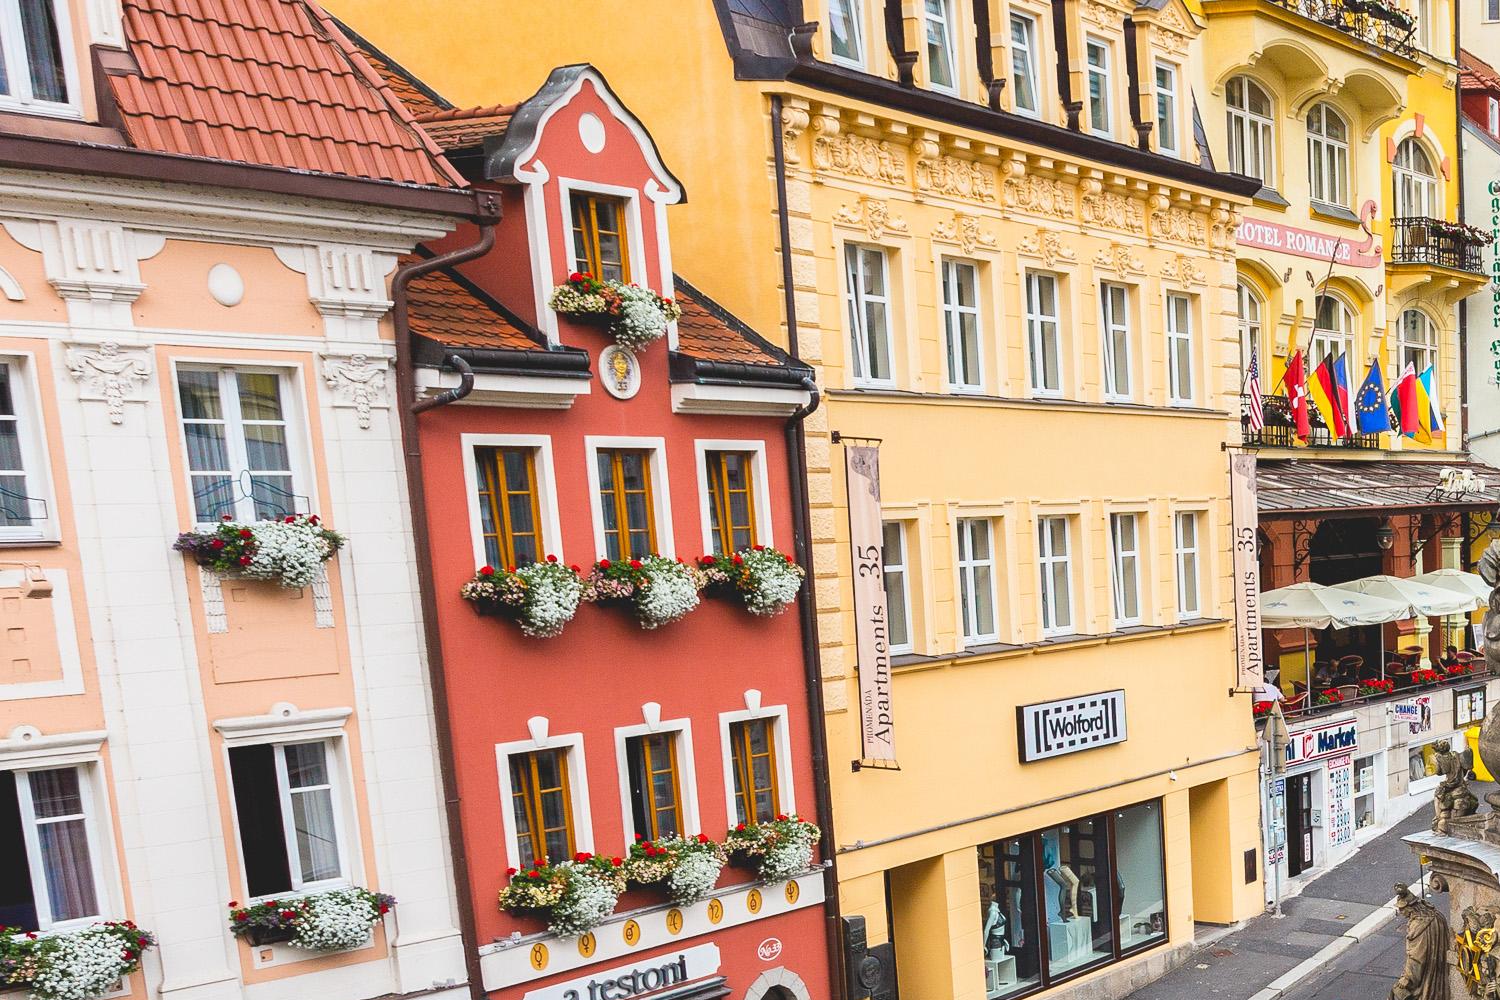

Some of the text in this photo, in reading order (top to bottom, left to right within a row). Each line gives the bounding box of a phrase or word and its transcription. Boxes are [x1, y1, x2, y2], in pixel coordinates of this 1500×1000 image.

[1236, 221, 1351, 261] HOTEL ROMANCE
[1236, 526, 1262, 676] Apartments 35
[857, 544, 894, 746] Apartments 35
[1049, 709, 1104, 740] Wolford
[1395, 704, 1418, 715] CHANGE
[1317, 726, 1356, 753] Market
